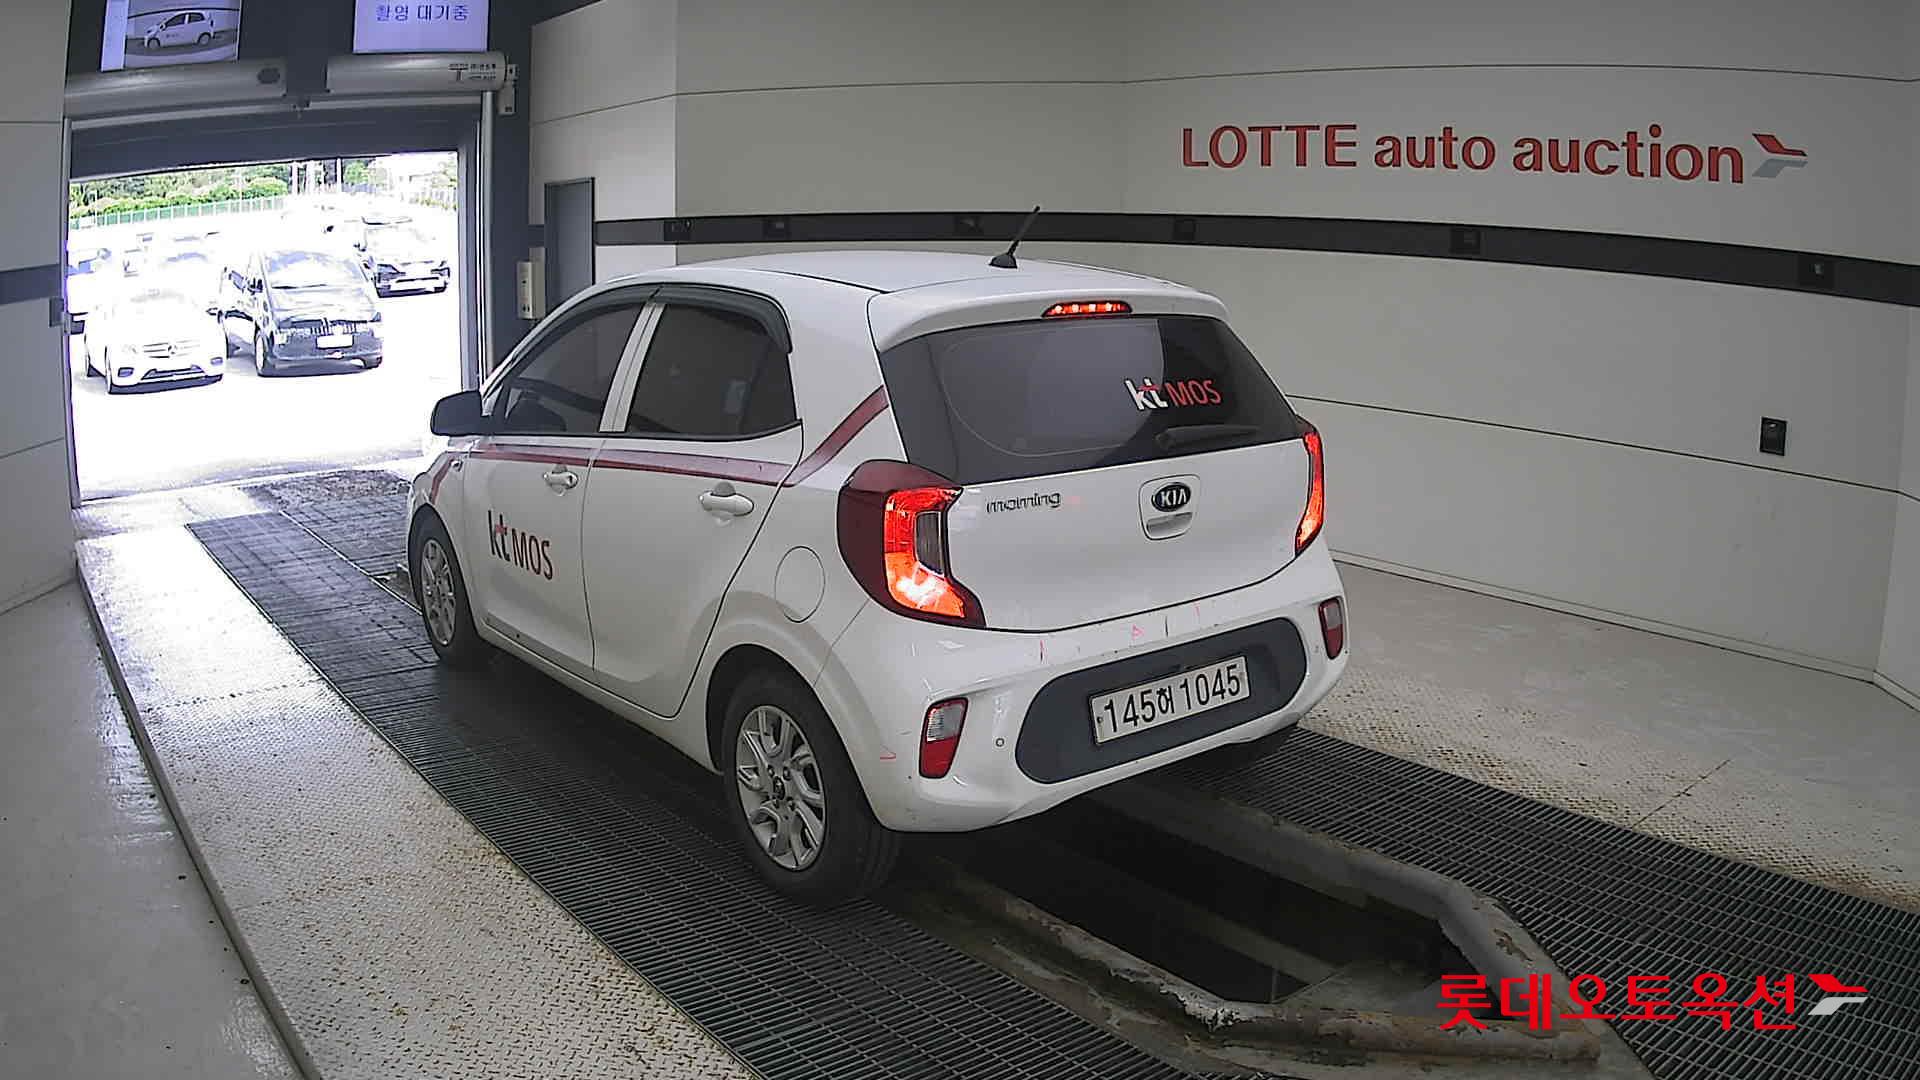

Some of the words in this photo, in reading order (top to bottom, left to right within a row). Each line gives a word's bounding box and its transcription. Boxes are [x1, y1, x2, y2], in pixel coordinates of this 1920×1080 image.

[417, 4, 469, 21] 대기중
[1182, 124, 1357, 168] LOTTE
[1374, 126, 1496, 170] auto
[1512, 124, 1744, 184] auction
[1124, 378, 1168, 410] kt
[1164, 379, 1221, 406] MOS
[986, 492, 1061, 513] morning
[1161, 488, 1188, 508] KIA
[487, 509, 511, 562] kt
[511, 528, 553, 580] MOS
